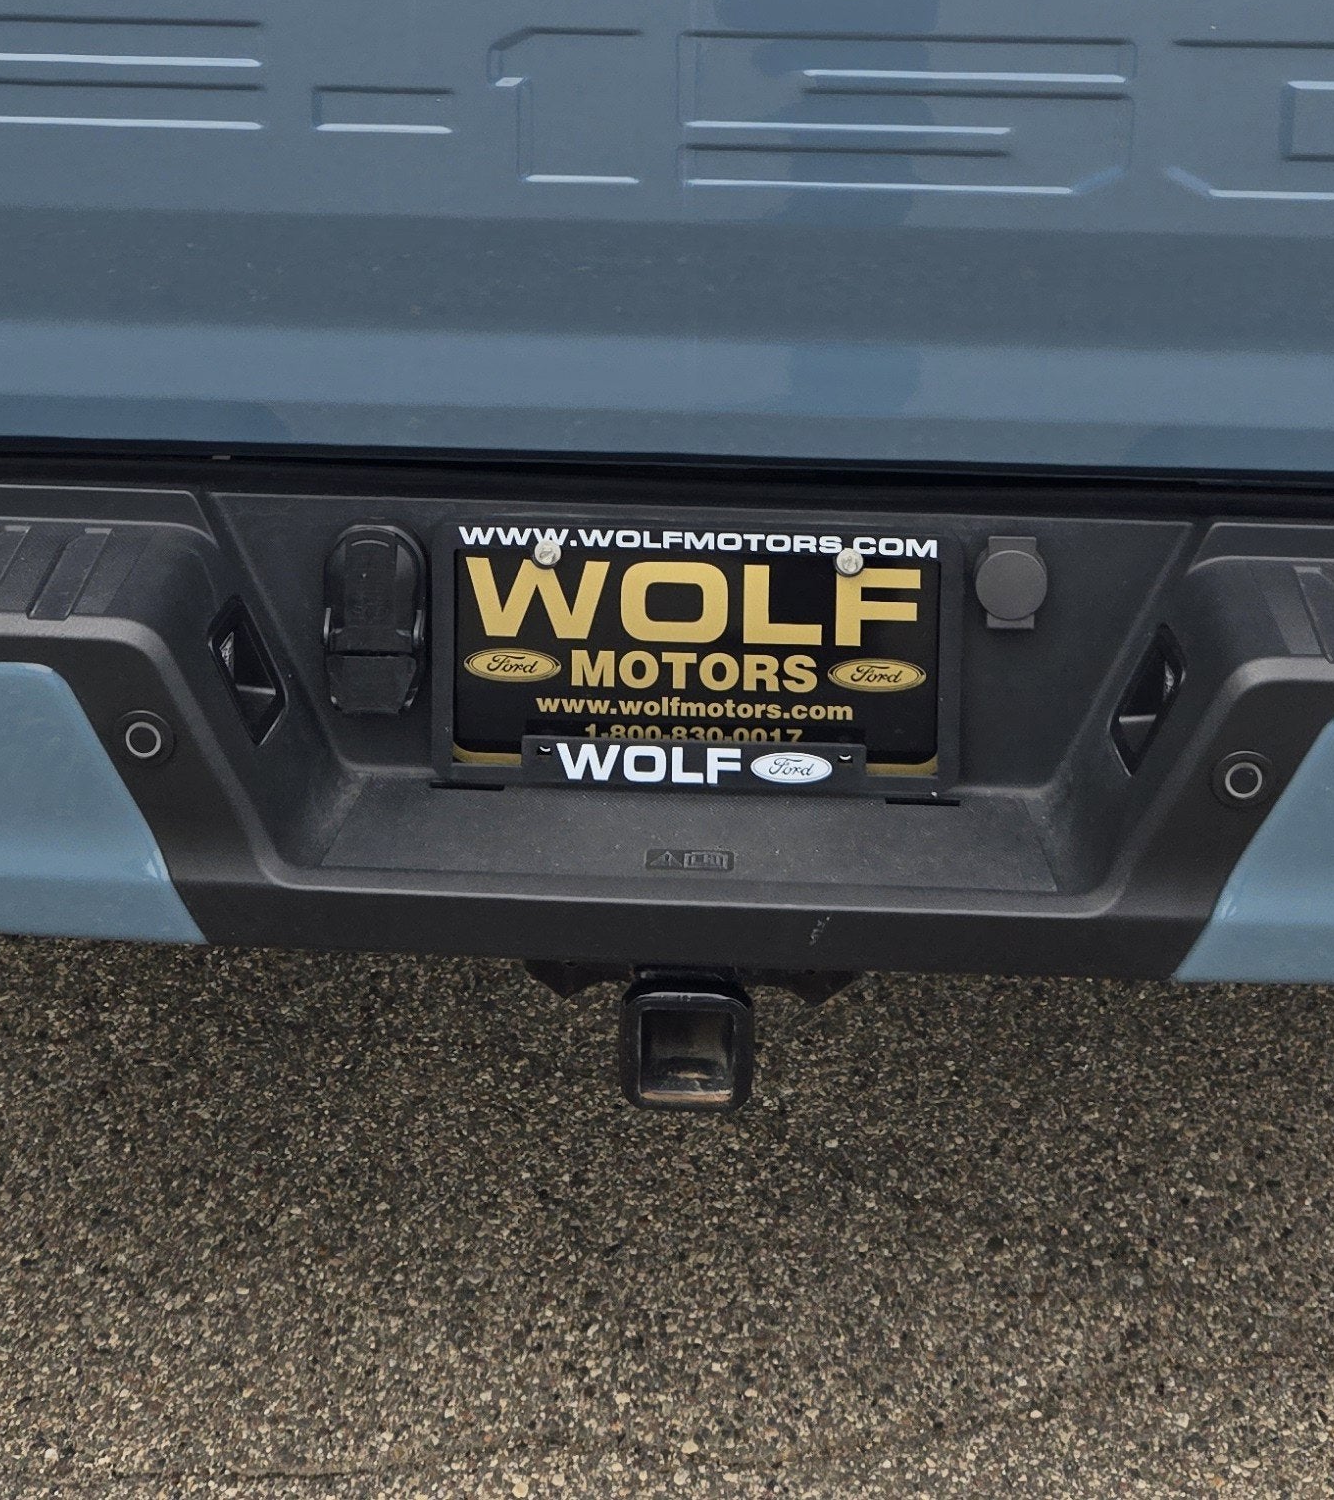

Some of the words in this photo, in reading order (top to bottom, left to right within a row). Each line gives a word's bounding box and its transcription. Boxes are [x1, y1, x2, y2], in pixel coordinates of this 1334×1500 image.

[458, 526, 938, 559] WWW.WOLFMOTORS.COM
[465, 556, 922, 647] WOLF
[486, 654, 538, 674] Ford
[571, 649, 818, 693] MOTORS
[850, 664, 902, 684] Ford
[535, 696, 854, 721] www.wolfmotors.com
[556, 742, 742, 786] WOLF
[768, 758, 814, 777] Ford
